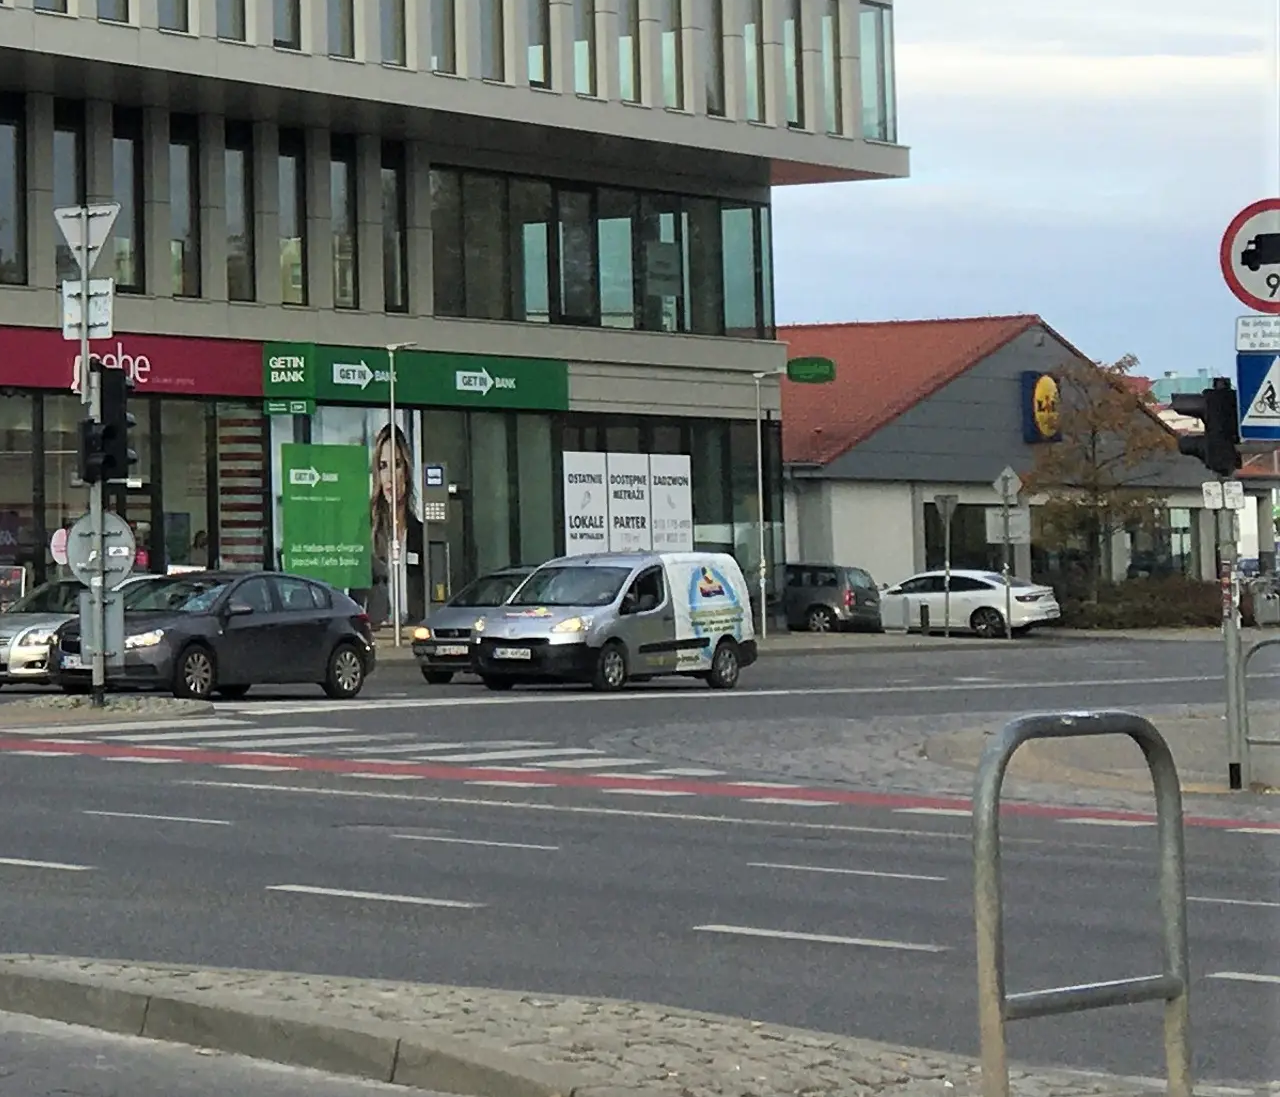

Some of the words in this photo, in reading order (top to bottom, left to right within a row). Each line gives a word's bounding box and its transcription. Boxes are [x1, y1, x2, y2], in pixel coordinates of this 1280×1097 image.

[269, 356, 305, 369] GETIN
[271, 371, 305, 383] BANK
[339, 368, 357, 380] GET
[462, 375, 478, 387] GET
[569, 516, 604, 529] LOKALE
[613, 516, 647, 529] PARTER
